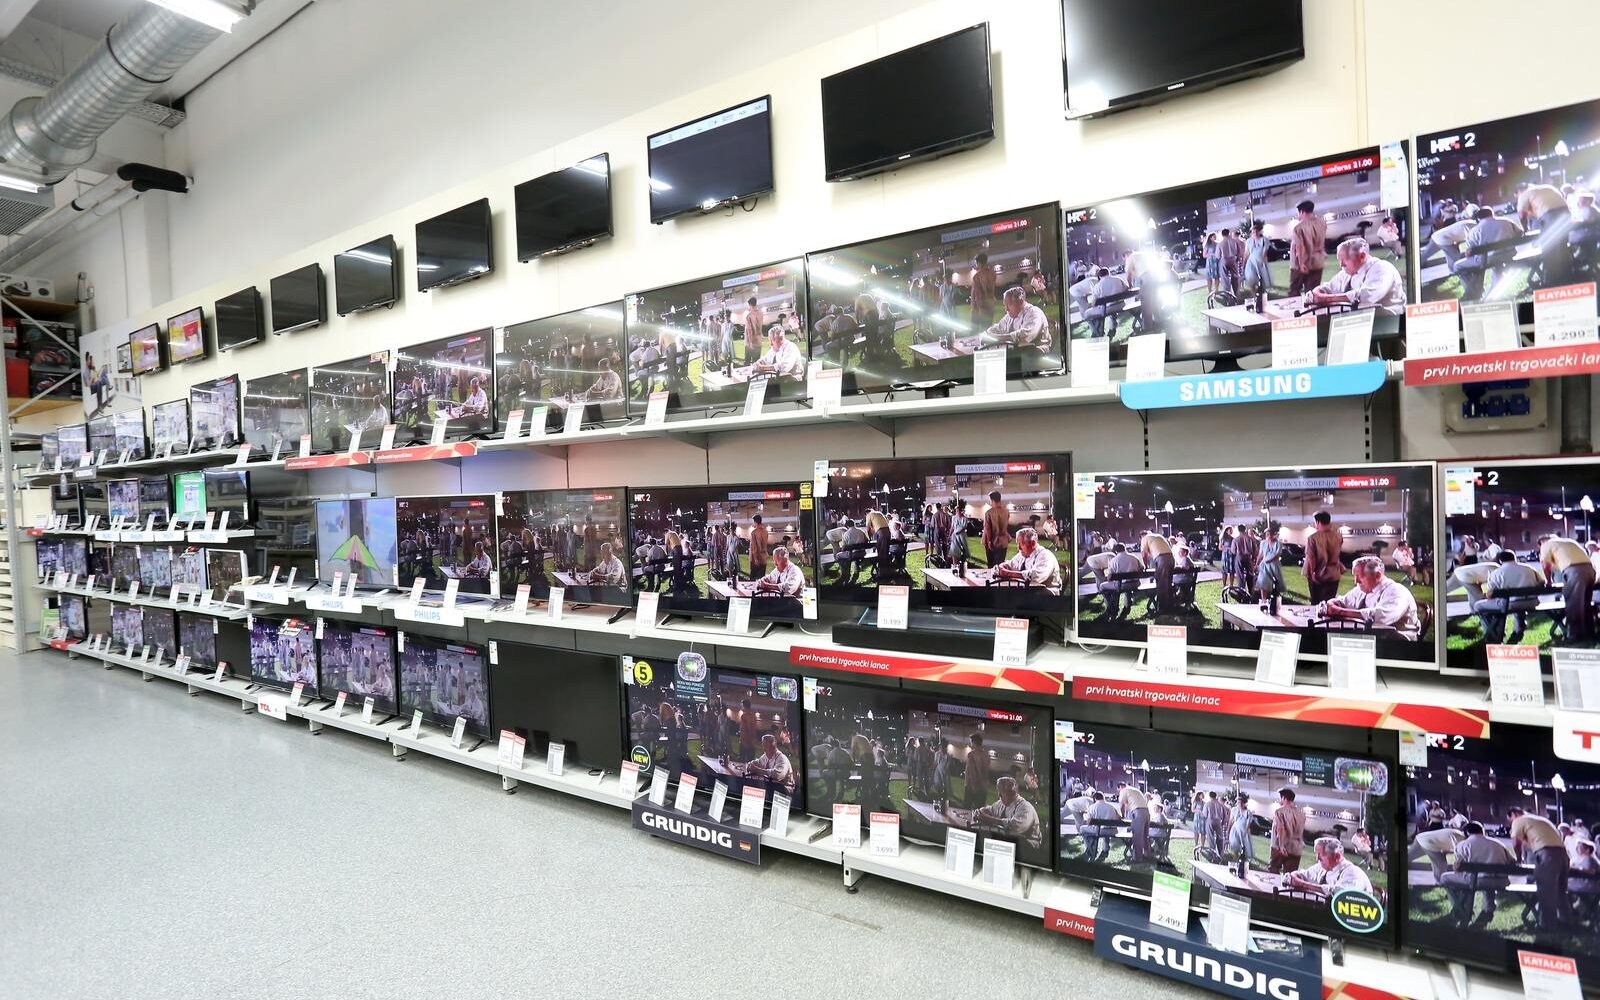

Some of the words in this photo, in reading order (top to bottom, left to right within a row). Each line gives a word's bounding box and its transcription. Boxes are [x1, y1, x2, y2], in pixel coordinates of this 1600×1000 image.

[1464, 133, 1476, 148] 2
[1325, 163, 1352, 174] večeras
[1353, 158, 1373, 169] 21.00
[1089, 209, 1097, 220] 2
[1538, 286, 1591, 301] KATALOG
[1411, 303, 1452, 316] AKCIJA
[1276, 319, 1312, 330] AKCIJA
[1548, 329, 1586, 342] 4.299
[1423, 364, 1450, 380] prvi
[1451, 359, 1507, 376] hrvatski
[1509, 352, 1578, 374] trgovački
[1180, 373, 1312, 402] SAMSUNG
[841, 467, 847, 477] 2
[1027, 463, 1041, 471] 21.00
[1342, 478, 1369, 487] večeras
[1369, 477, 1389, 487] 21.00
[1487, 470, 1499, 486] 2
[1107, 481, 1116, 493] 2
[645, 493, 651, 501] 2
[413, 609, 441, 621] PHILIPS
[1000, 619, 1025, 629] AKCIJA
[1151, 628, 1182, 637] AKCIJA
[1490, 648, 1535, 657] KATALOG
[799, 653, 812, 662] prvi
[811, 655, 838, 664] hrvatski
[838, 657, 870, 667] trgovački
[870, 661, 890, 671] lanac
[639, 665, 648, 681] 5
[827, 687, 833, 697] 2
[1085, 685, 1104, 696] prvi
[1105, 685, 1143, 698] hrvatski
[1144, 690, 1190, 703] trgovački
[1192, 693, 1220, 706] lanac
[259, 703, 271, 713] TCL
[1087, 733, 1096, 744] 2
[1453, 735, 1465, 750] 2
[633, 753, 649, 764] NEW
[641, 811, 733, 849] GRUNDIG
[1337, 901, 1378, 920] NEW
[1056, 918, 1073, 930] prvi
[1111, 934, 1299, 1000] GRUNDIG
[1523, 956, 1572, 972] KATALOG
